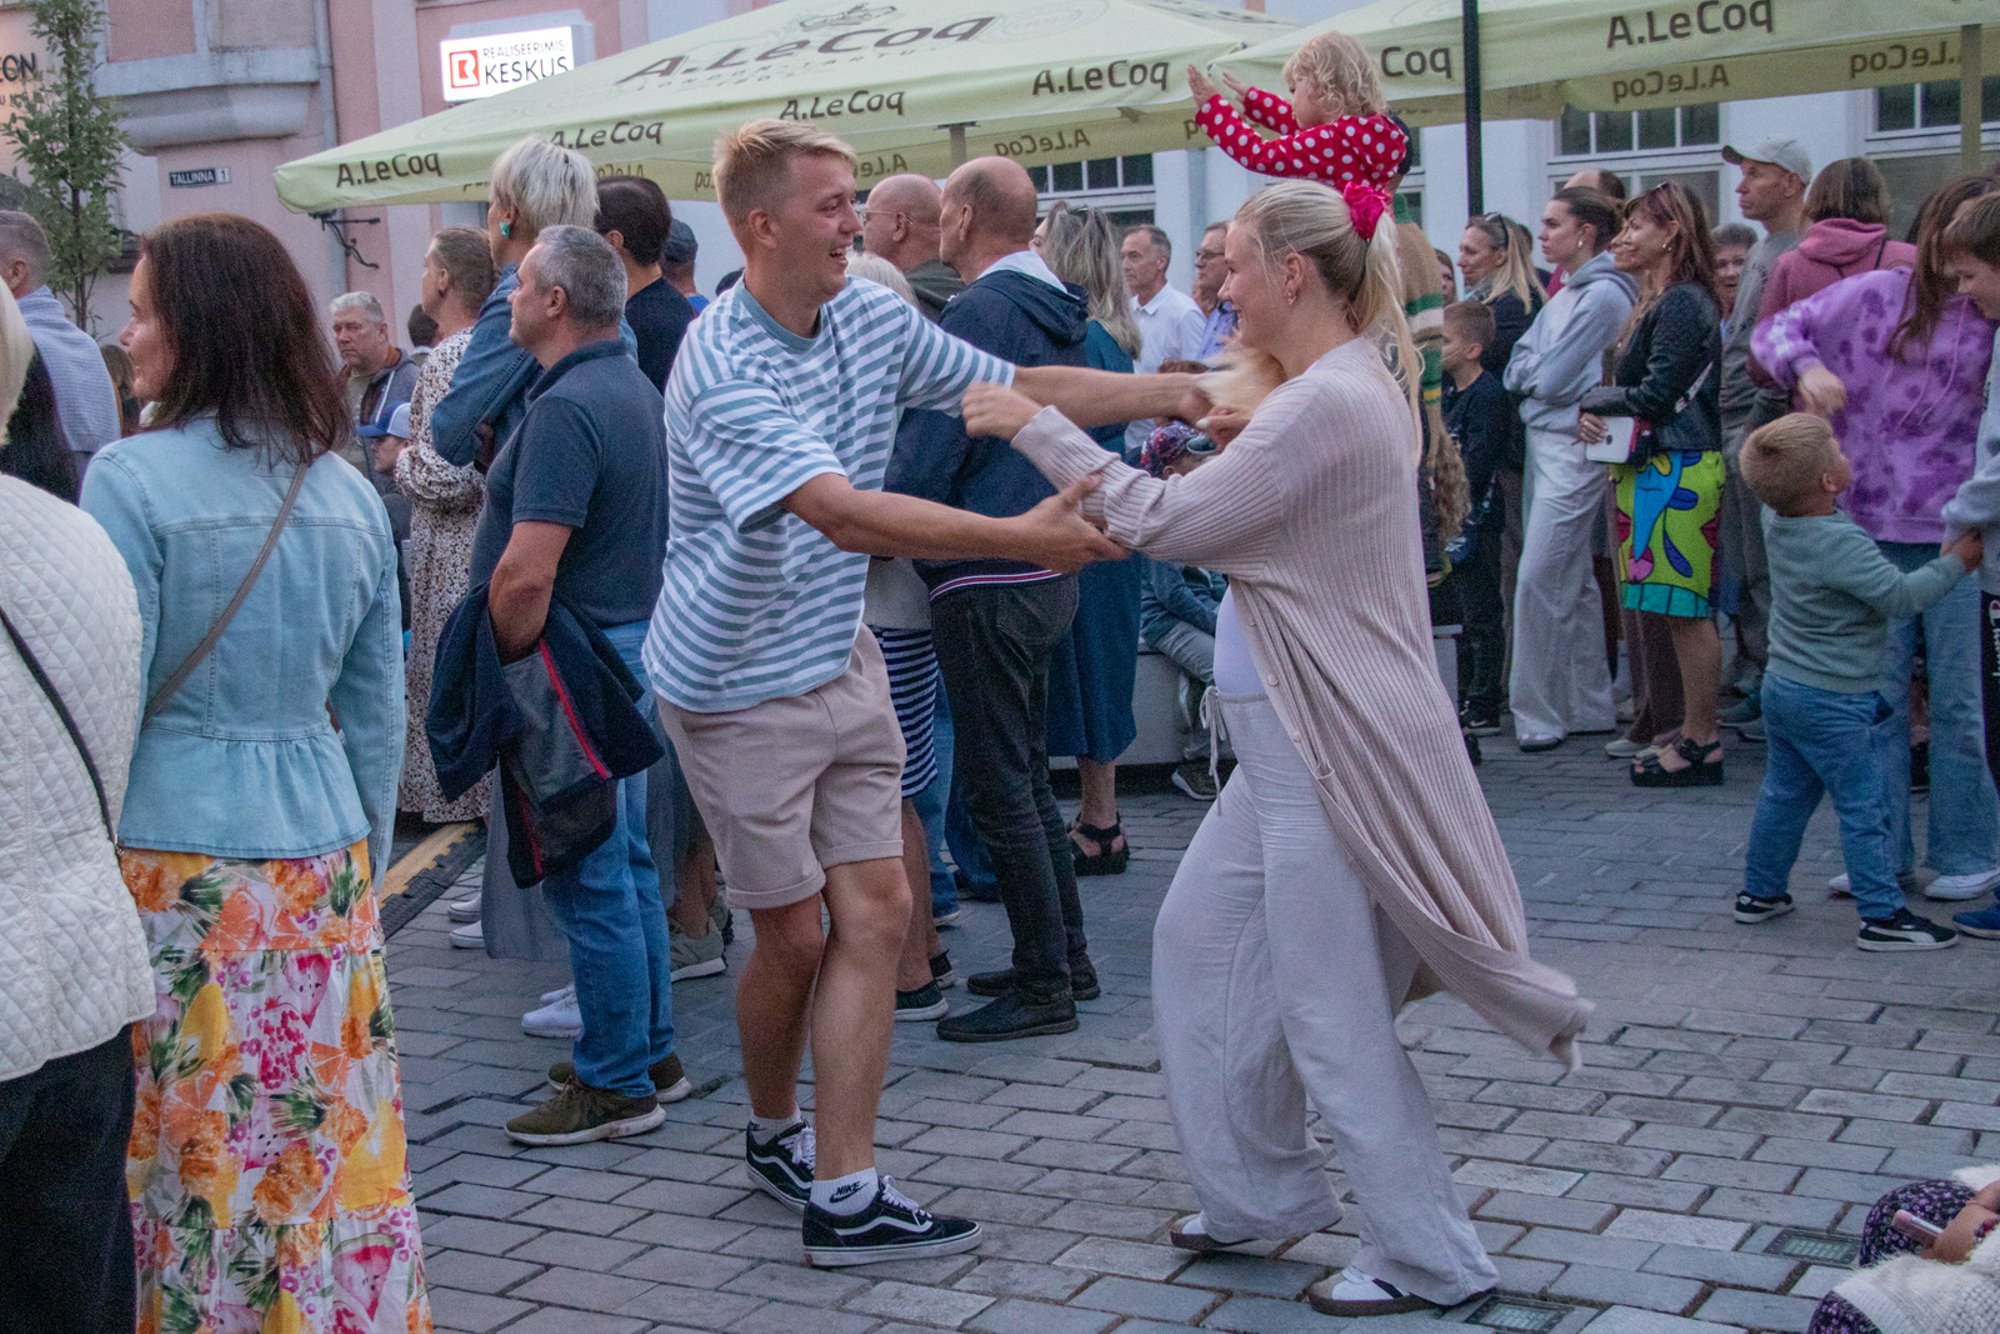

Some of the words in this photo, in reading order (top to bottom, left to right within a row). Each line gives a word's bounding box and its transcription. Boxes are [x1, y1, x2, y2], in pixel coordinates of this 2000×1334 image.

[482, 40, 566, 59] REALISEERIMIS
[485, 56, 569, 85] KESKUS
[171, 170, 215, 185] TALLINNA
